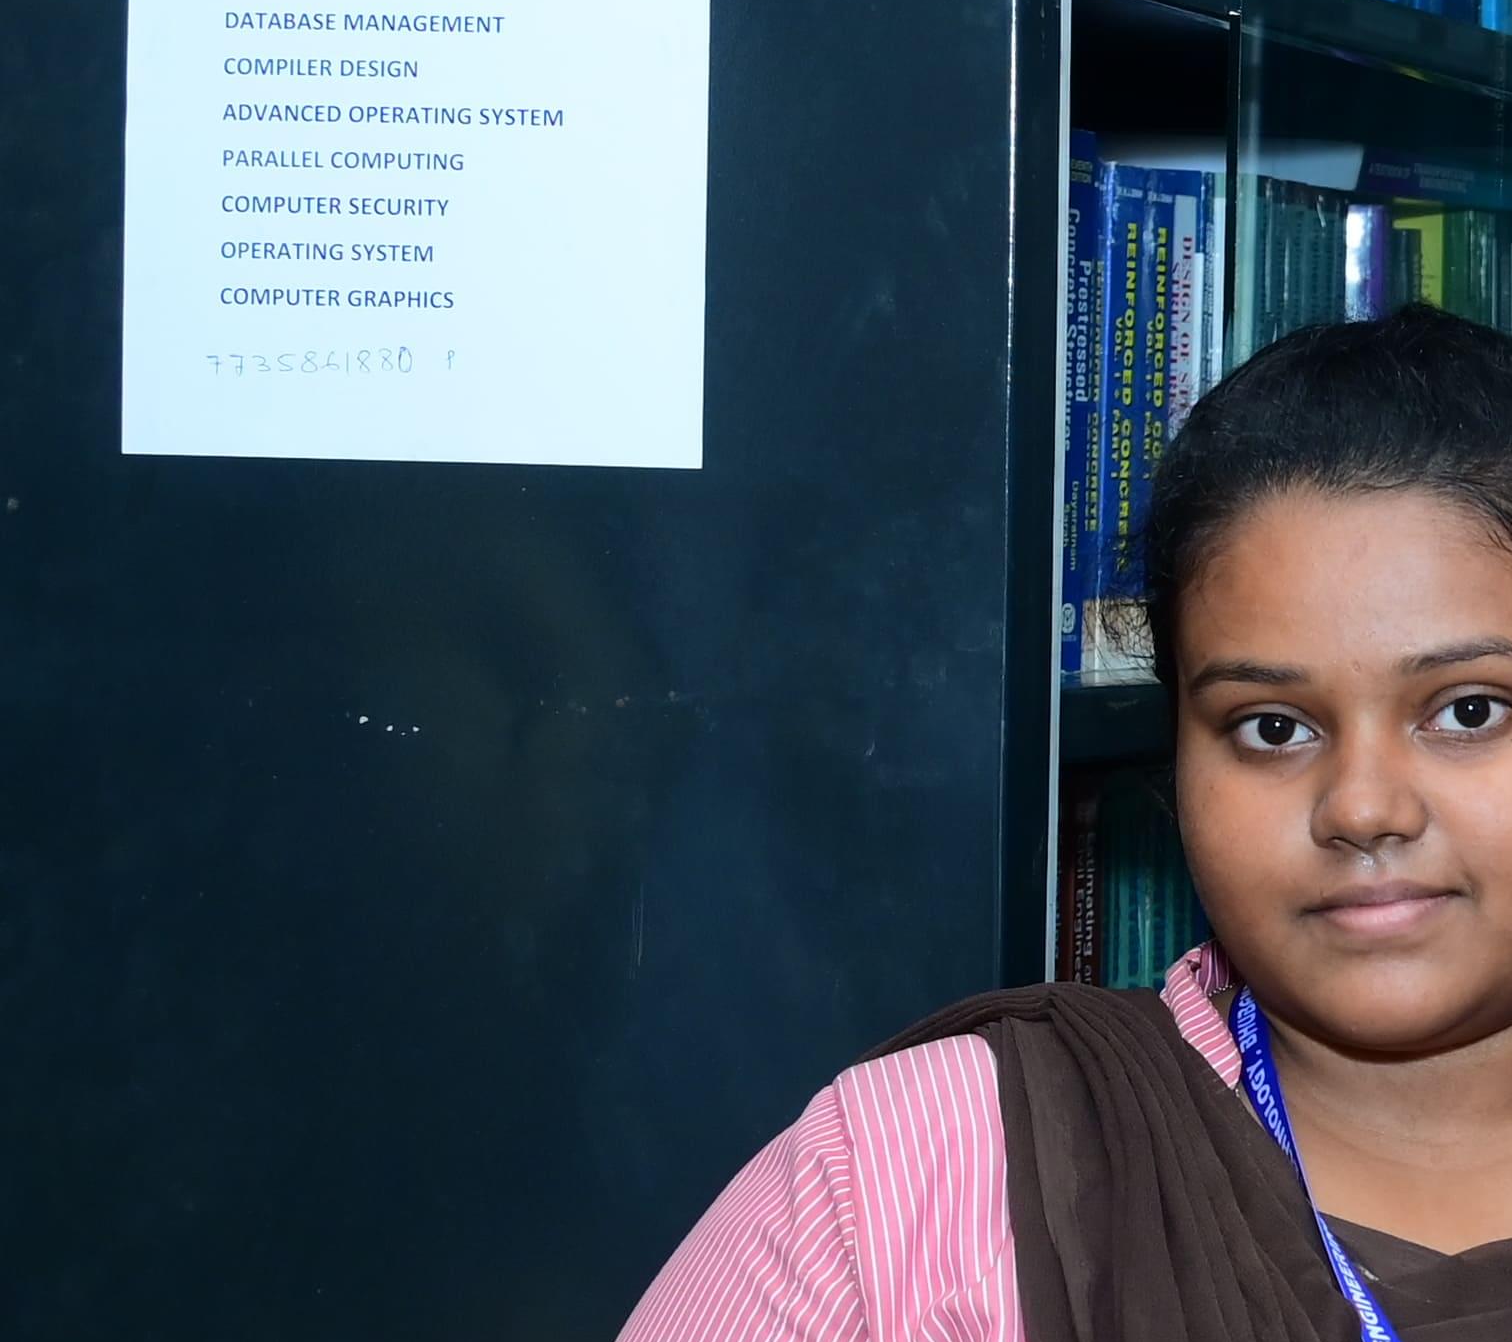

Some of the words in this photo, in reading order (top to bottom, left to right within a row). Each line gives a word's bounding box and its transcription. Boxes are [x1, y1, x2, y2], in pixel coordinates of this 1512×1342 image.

[225, 11, 337, 31] DATABASE
[343, 13, 505, 34] MANAGEMENT
[223, 57, 332, 77] COMPILER
[340, 59, 418, 79] DESIGN
[222, 103, 342, 123] ADVANCED
[348, 105, 472, 125] OPERATING
[479, 107, 564, 127] SYSTEM
[222, 149, 324, 169] PARALLEL
[330, 151, 464, 171] COMPUTING
[221, 195, 342, 215] COMPUTER
[348, 197, 449, 217] SECURITY
[220, 241, 344, 261] OPERATING
[350, 243, 434, 263] SYSTEM
[1181, 236, 1194, 323] DESIGN
[220, 287, 341, 307] COMPUTER
[347, 289, 454, 309] GRAPHICS
[1123, 222, 1138, 407] REINFORCED
[1153, 226, 1169, 408] REINFORCED
[1074, 260, 1093, 403] Prestressed
